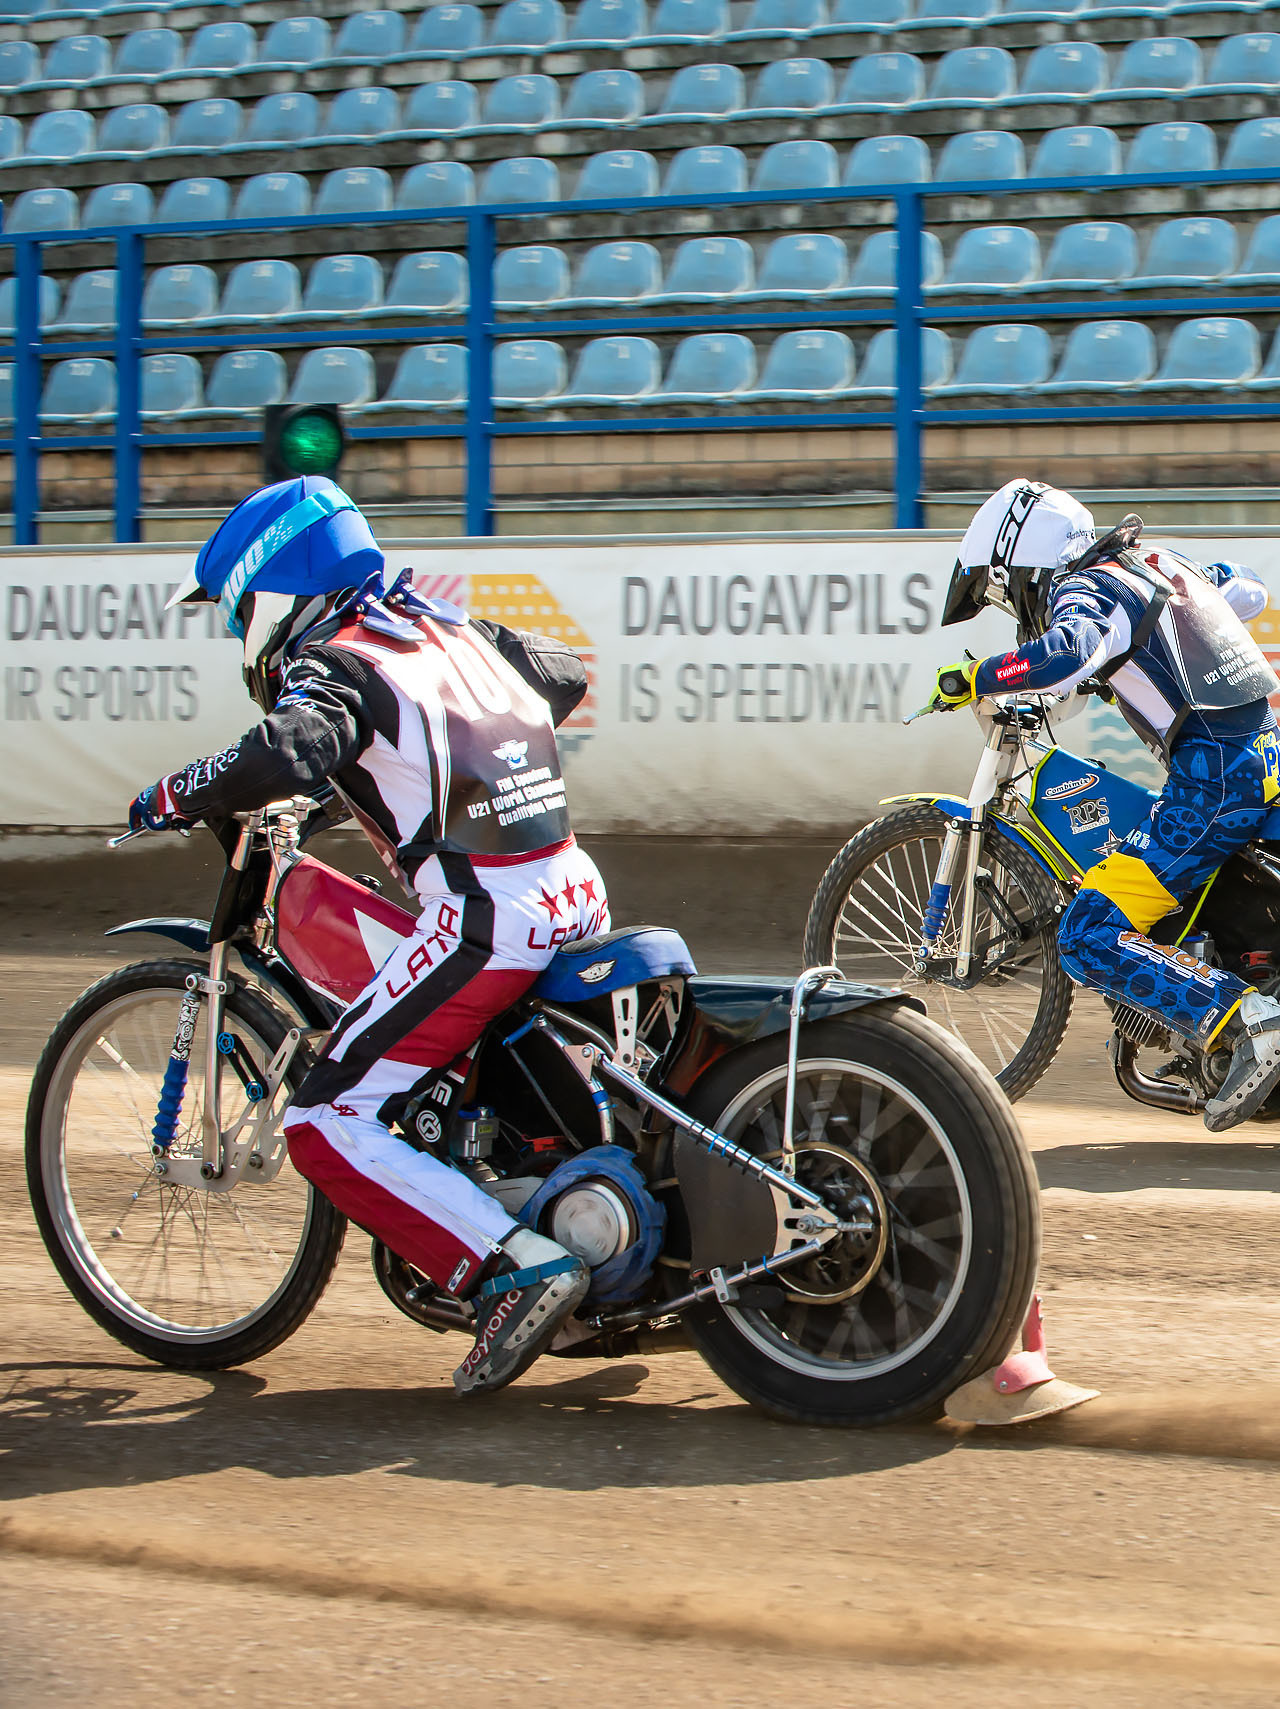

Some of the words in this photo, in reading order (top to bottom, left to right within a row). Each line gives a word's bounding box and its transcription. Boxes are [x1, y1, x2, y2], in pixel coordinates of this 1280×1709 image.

[6, 583, 238, 641] DAUGAVPI
[622, 573, 933, 636] DAUGAVPILS
[5, 666, 41, 721] IR
[54, 665, 199, 722] SPORTS
[619, 663, 661, 722] IS
[676, 663, 911, 723] SPEEDWAY
[1203, 669, 1221, 685] U21
[467, 801, 491, 819] U21
[492, 789, 526, 812] World
[1045, 776, 1091, 797] Combimix
[1067, 797, 1110, 829] RPS
